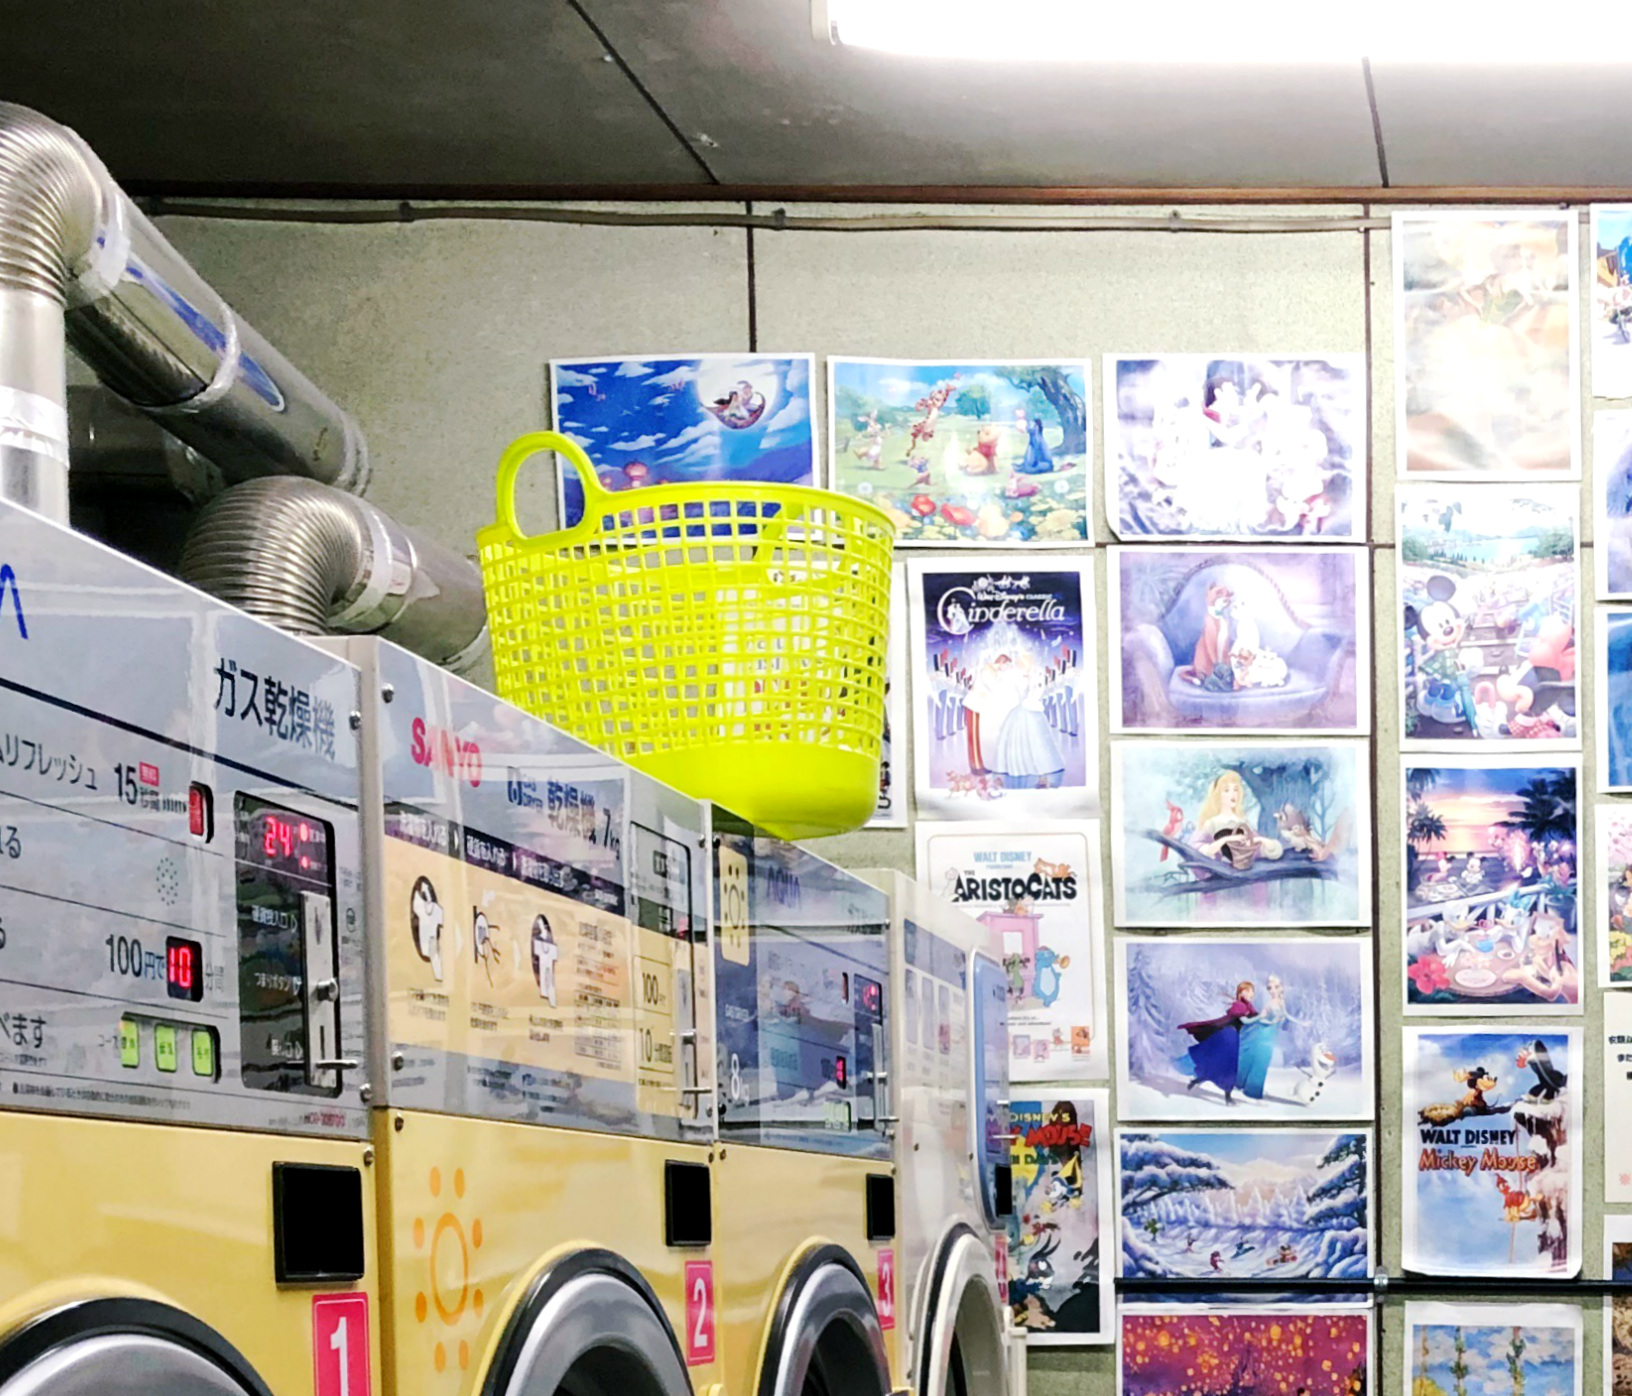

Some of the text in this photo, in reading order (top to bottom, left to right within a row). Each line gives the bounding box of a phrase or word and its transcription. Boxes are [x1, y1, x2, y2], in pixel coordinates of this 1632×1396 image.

[937, 586, 1065, 635] Cinderella
[213, 657, 336, 758] ガス乾燥機
[0, 733, 98, 791] リフレッシュ
[113, 762, 139, 805] 15
[411, 717, 482, 788] SANYO
[973, 851, 1032, 863] WALT DISNEY
[952, 872, 1077, 903] ARISTOCATS
[1025, 1122, 1093, 1148] MOUSE
[1420, 1129, 1517, 1148] WALT DISNEY
[1419, 1147, 1538, 1176] Mickey Mouse
[692, 1277, 708, 1348] 2
[880, 1261, 892, 1319] 3
